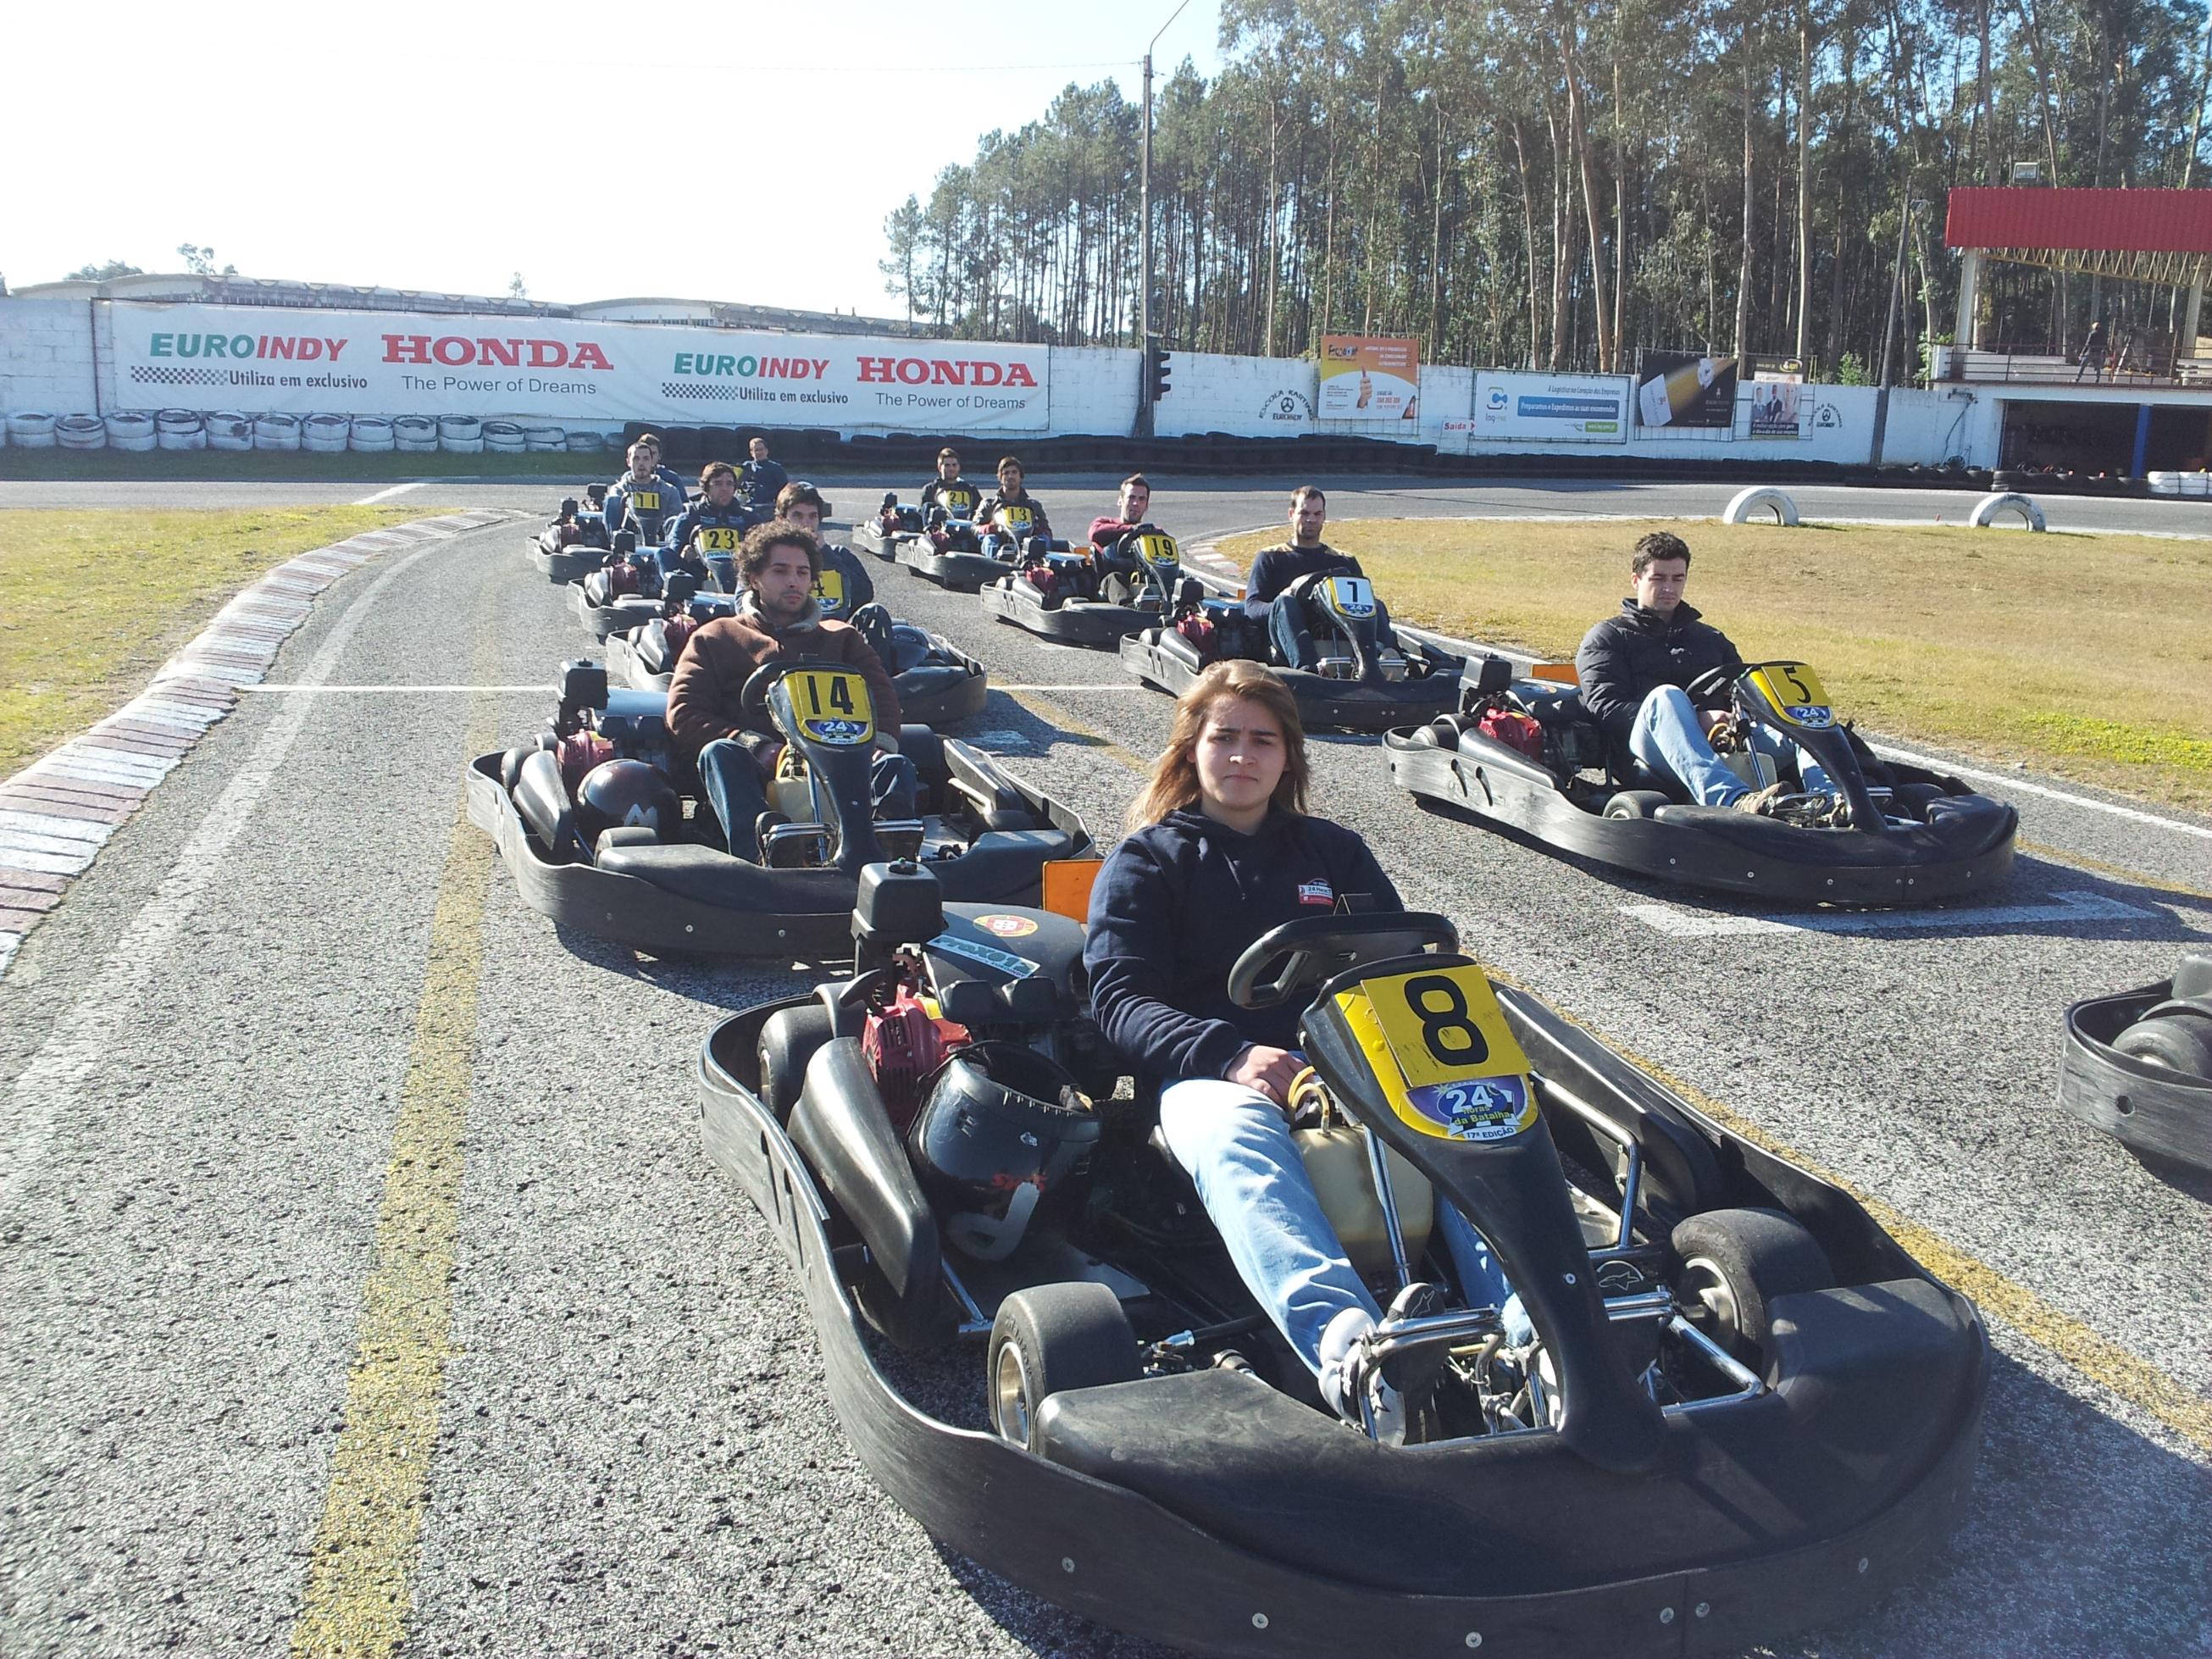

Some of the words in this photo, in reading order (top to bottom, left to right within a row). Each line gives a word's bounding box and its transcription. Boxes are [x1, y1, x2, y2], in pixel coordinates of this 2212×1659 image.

[150, 332, 348, 362] EUROINDY
[381, 334, 614, 370] HONDA
[674, 352, 830, 380] EUROINDY
[857, 356, 1038, 387] HONDA
[230, 369, 275, 386] Utiliza
[280, 375, 302, 387] em
[306, 372, 368, 388] exclusivo
[402, 375, 437, 391] The
[443, 376, 502, 392] Power
[507, 377, 524, 392] of
[529, 378, 596, 395] Dreams
[739, 386, 776, 402] Utiliza
[779, 392, 796, 402] em
[800, 389, 849, 404] exclusivo
[875, 392, 903, 407] The
[907, 394, 952, 408] Power
[956, 395, 970, 408] of
[974, 396, 1025, 409] Dreams
[950, 491, 965, 503] 21
[1011, 508, 1027, 521] 13
[708, 530, 735, 550] 23
[1151, 537, 1174, 557] 19
[807, 674, 855, 715] 14
[1783, 666, 1811, 703] 5
[1801, 707, 1819, 717] 24
[823, 721, 848, 732] 24
[1404, 974, 1489, 1067] 8
[1445, 1086, 1494, 1114] 24
[1454, 1117, 1468, 1126] da
[1472, 1109, 1512, 1124] Batalha
[1483, 1127, 1515, 1140] EDIÇÃO
